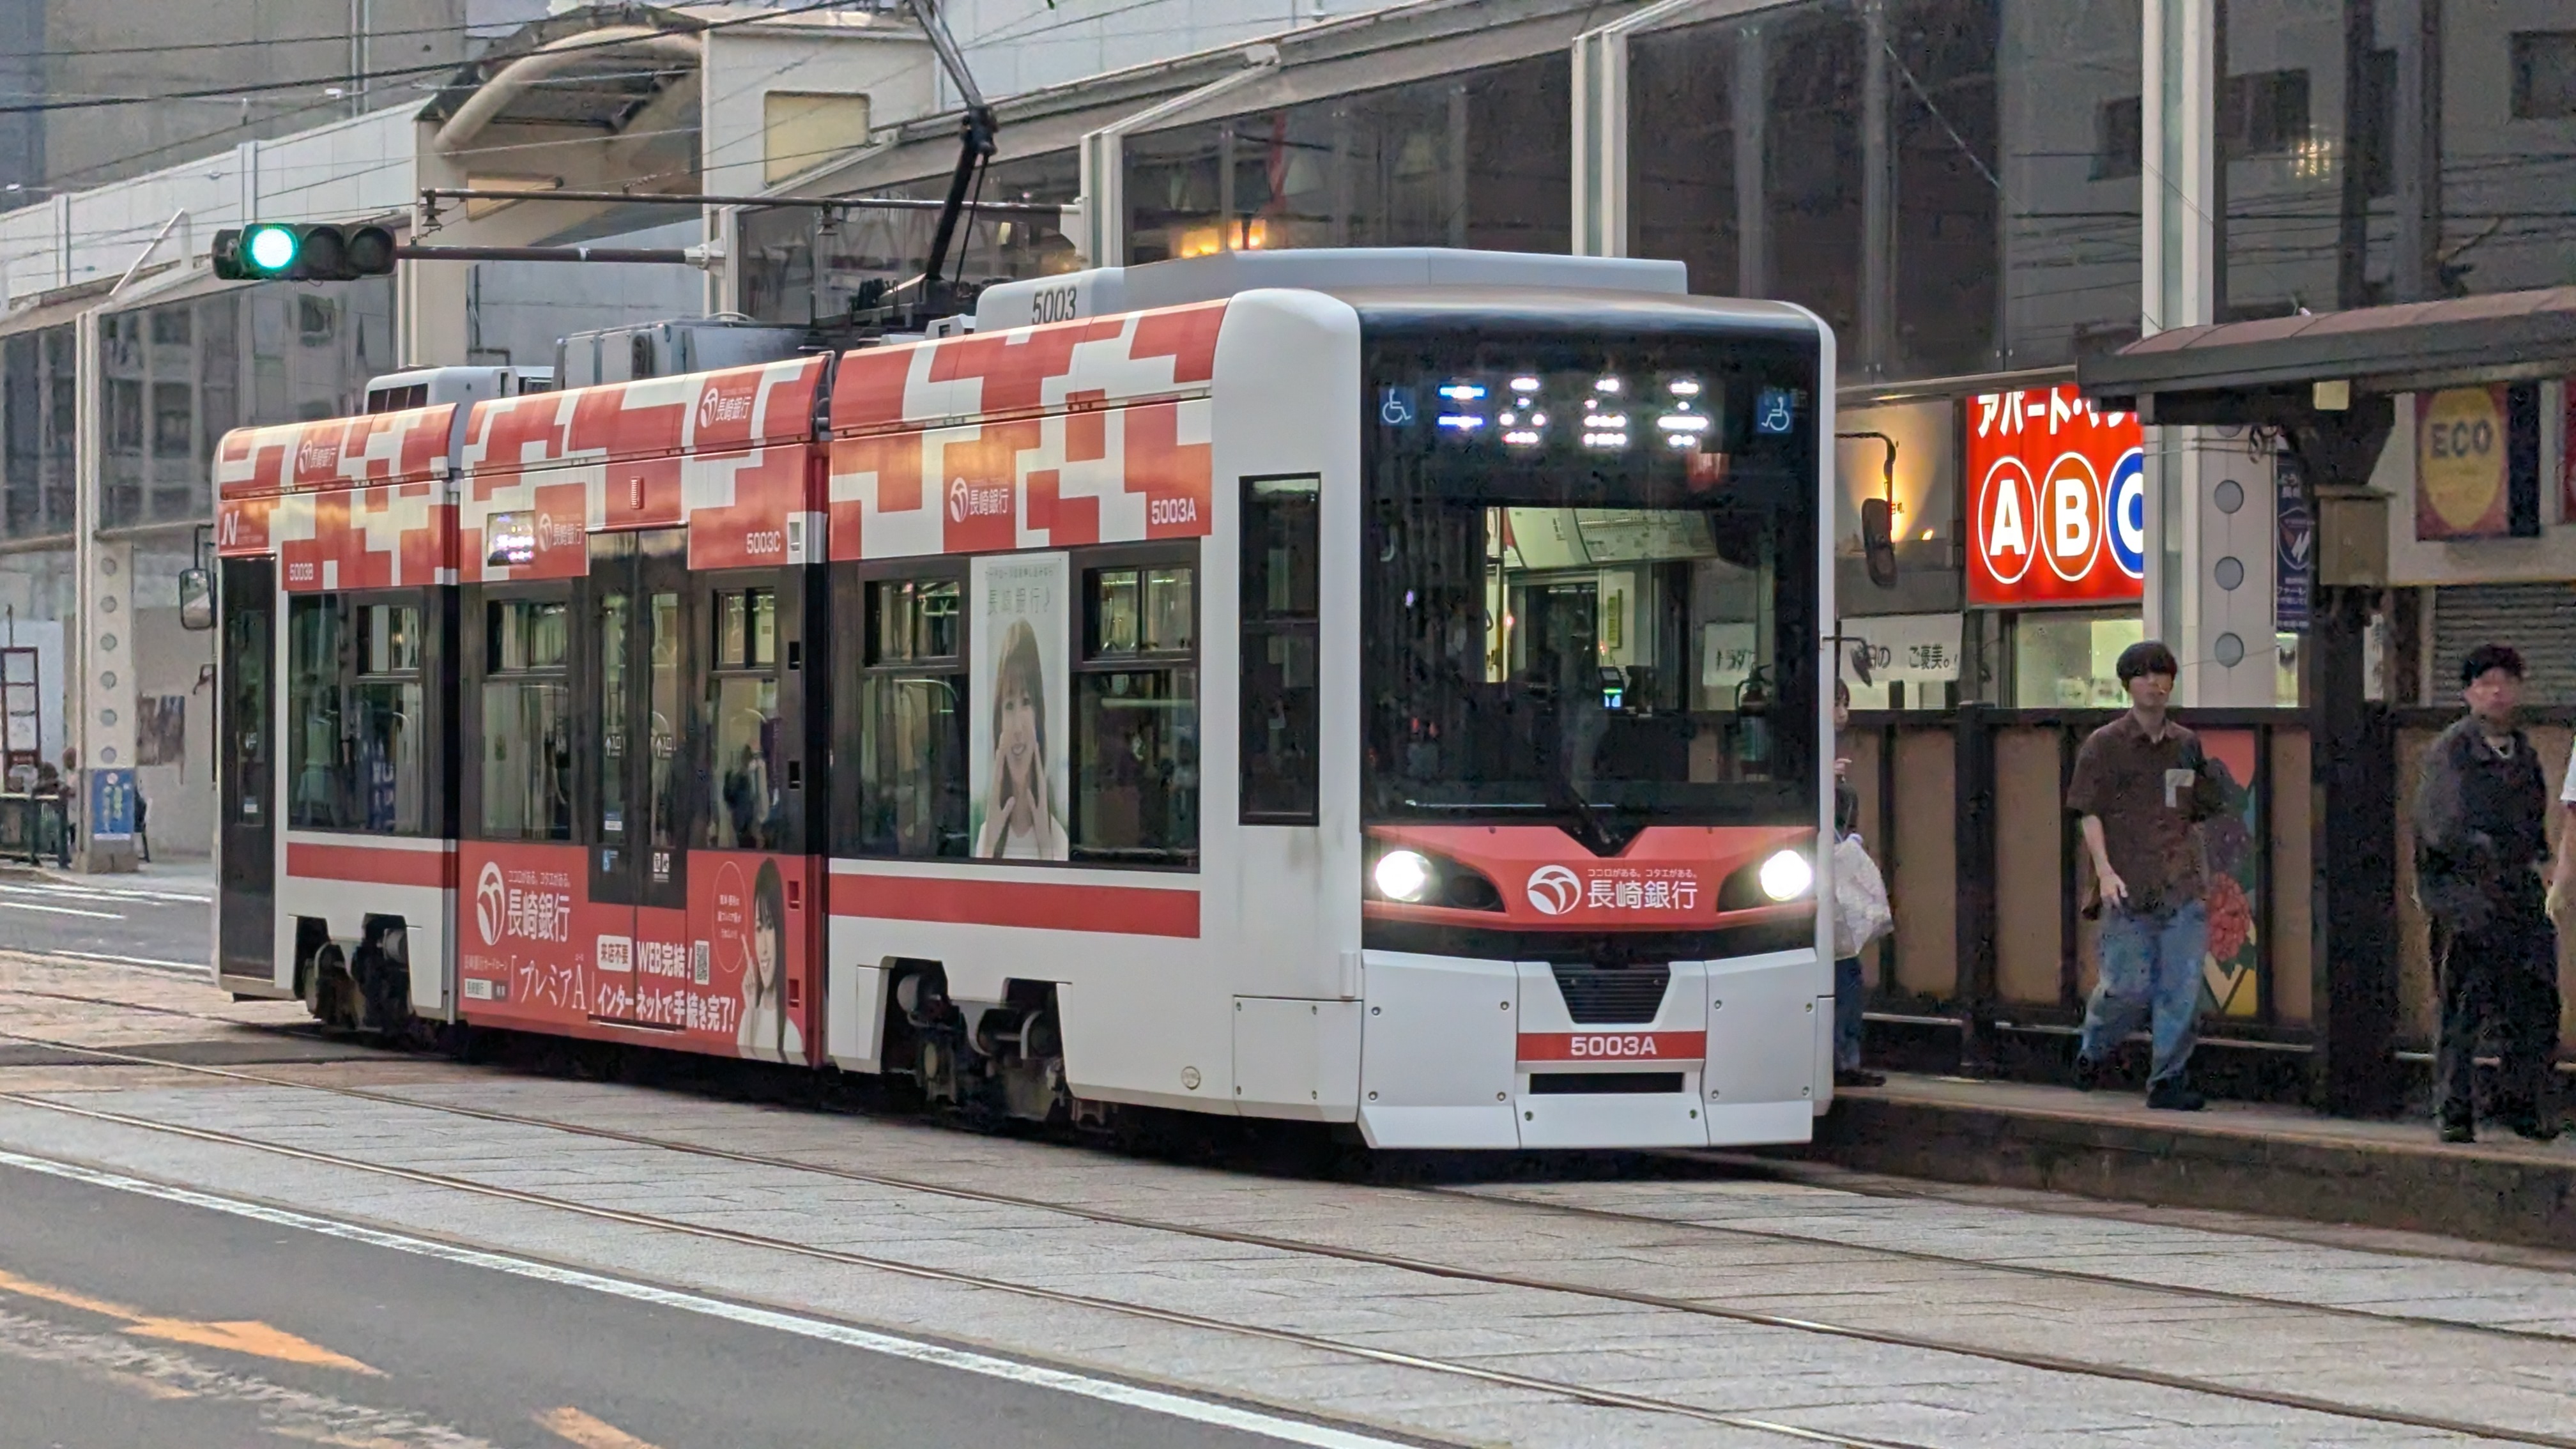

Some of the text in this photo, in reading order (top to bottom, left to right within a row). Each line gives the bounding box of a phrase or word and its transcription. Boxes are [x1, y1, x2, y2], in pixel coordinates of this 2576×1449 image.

[1032, 284, 1077, 325] 5003
[2430, 419, 2493, 459] ECO
[1152, 498, 1197, 525] 5003A
[747, 531, 780, 554] 5003C
[1909, 644, 1950, 670] ご褒美。
[1588, 869, 1698, 878] ココロがある。 コタエがある。
[1588, 880, 1698, 909] 長崎銀行
[508, 889, 570, 942] 長崎銀行
[598, 983, 735, 1033] インターネットで手続き完了!
[1571, 1036, 1657, 1055] 5003A
